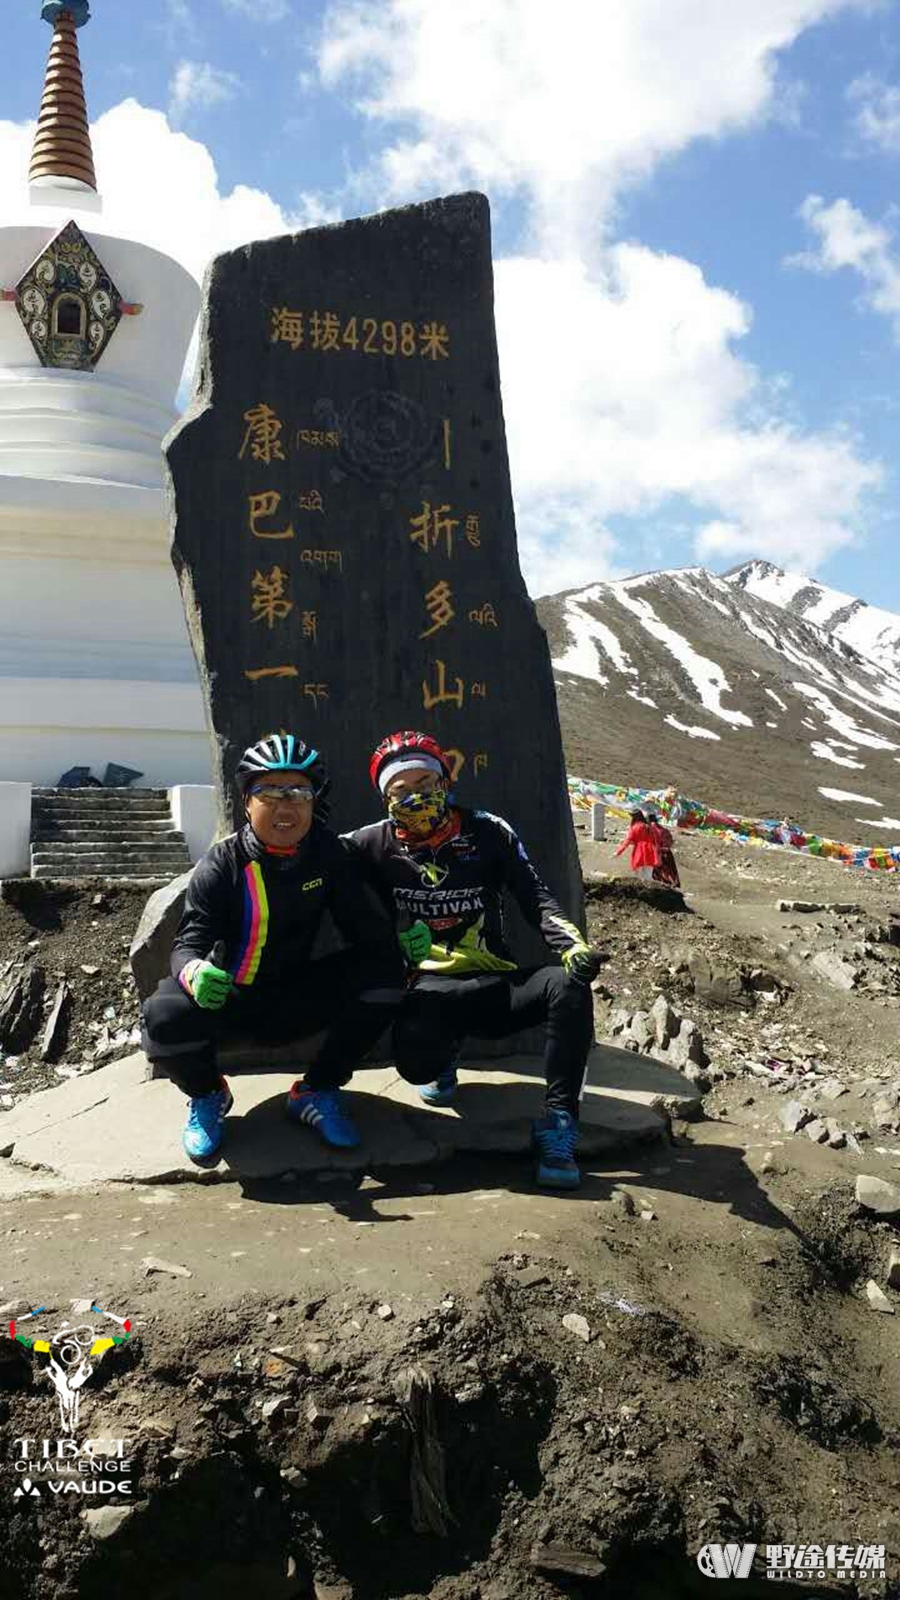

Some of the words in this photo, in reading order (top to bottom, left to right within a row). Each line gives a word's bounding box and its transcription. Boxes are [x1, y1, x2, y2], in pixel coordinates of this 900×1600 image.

[270, 307, 450, 361] 海拔4298米
[238, 403, 299, 741] 康巴第一
